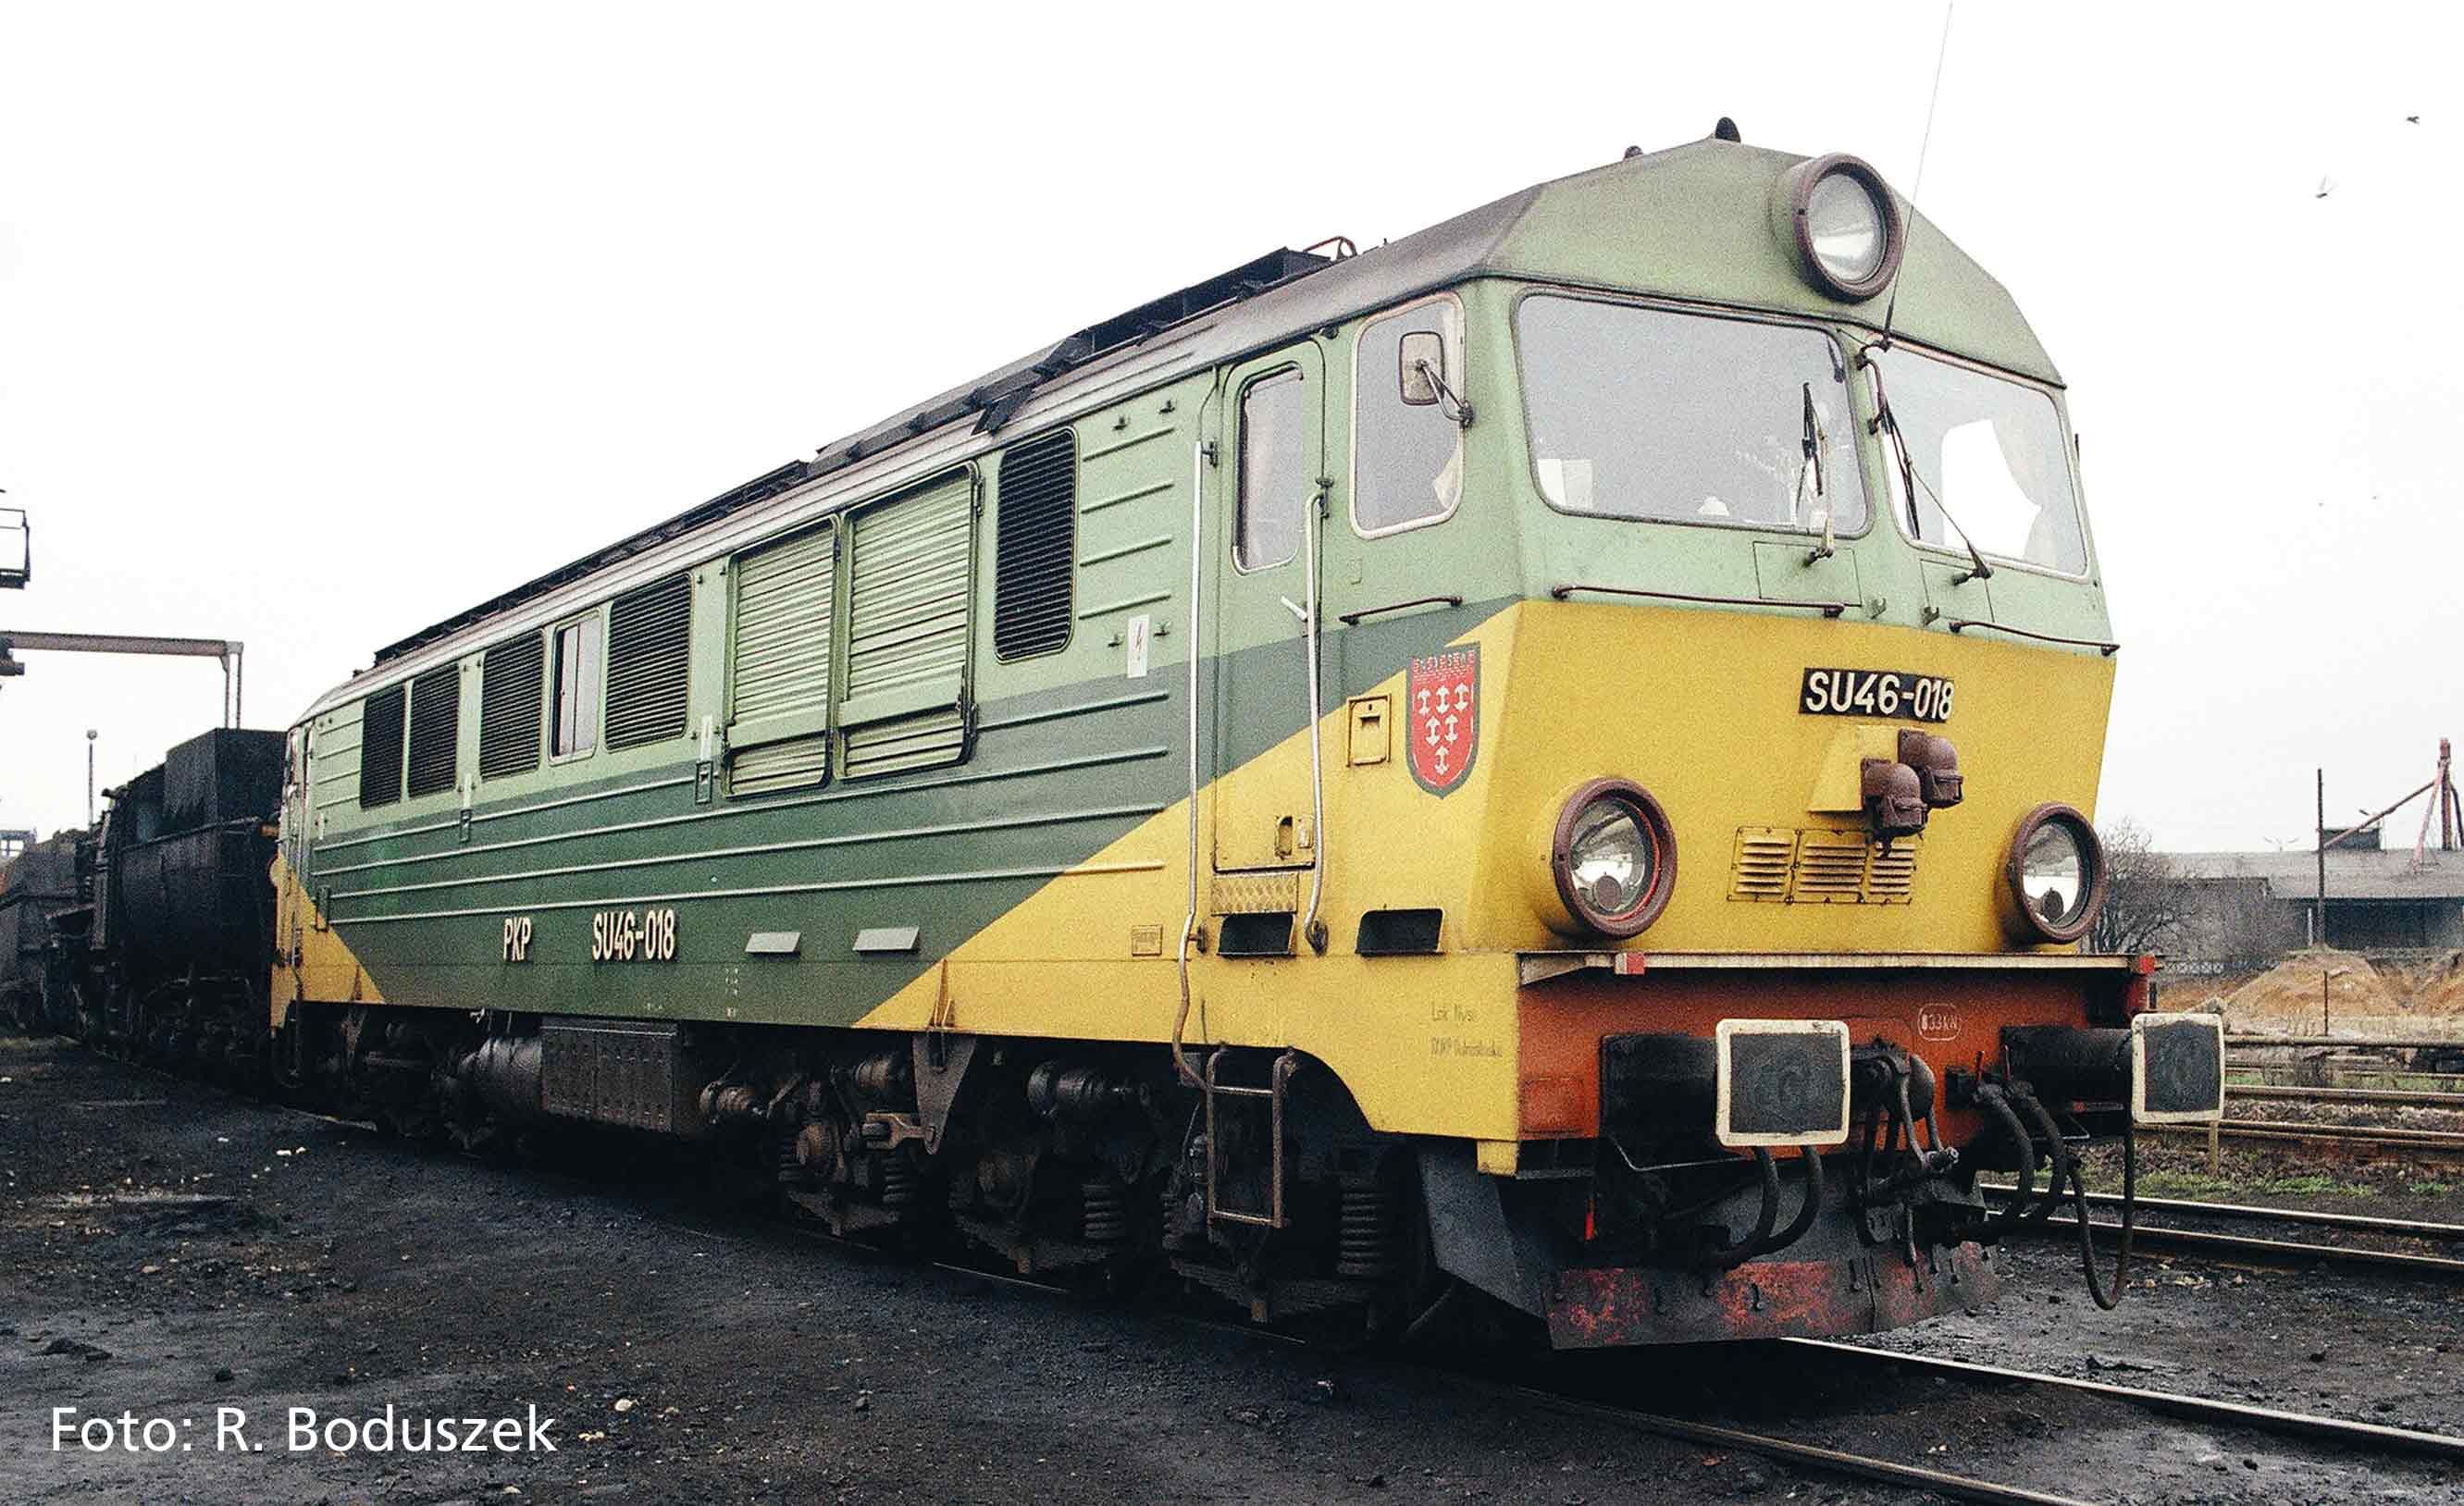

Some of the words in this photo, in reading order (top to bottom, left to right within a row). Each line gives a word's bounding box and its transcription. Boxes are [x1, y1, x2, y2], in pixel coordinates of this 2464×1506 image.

[1805, 671, 1955, 720] SU46-018
[503, 917, 531, 960] PKP
[593, 909, 675, 959] SU46-018
